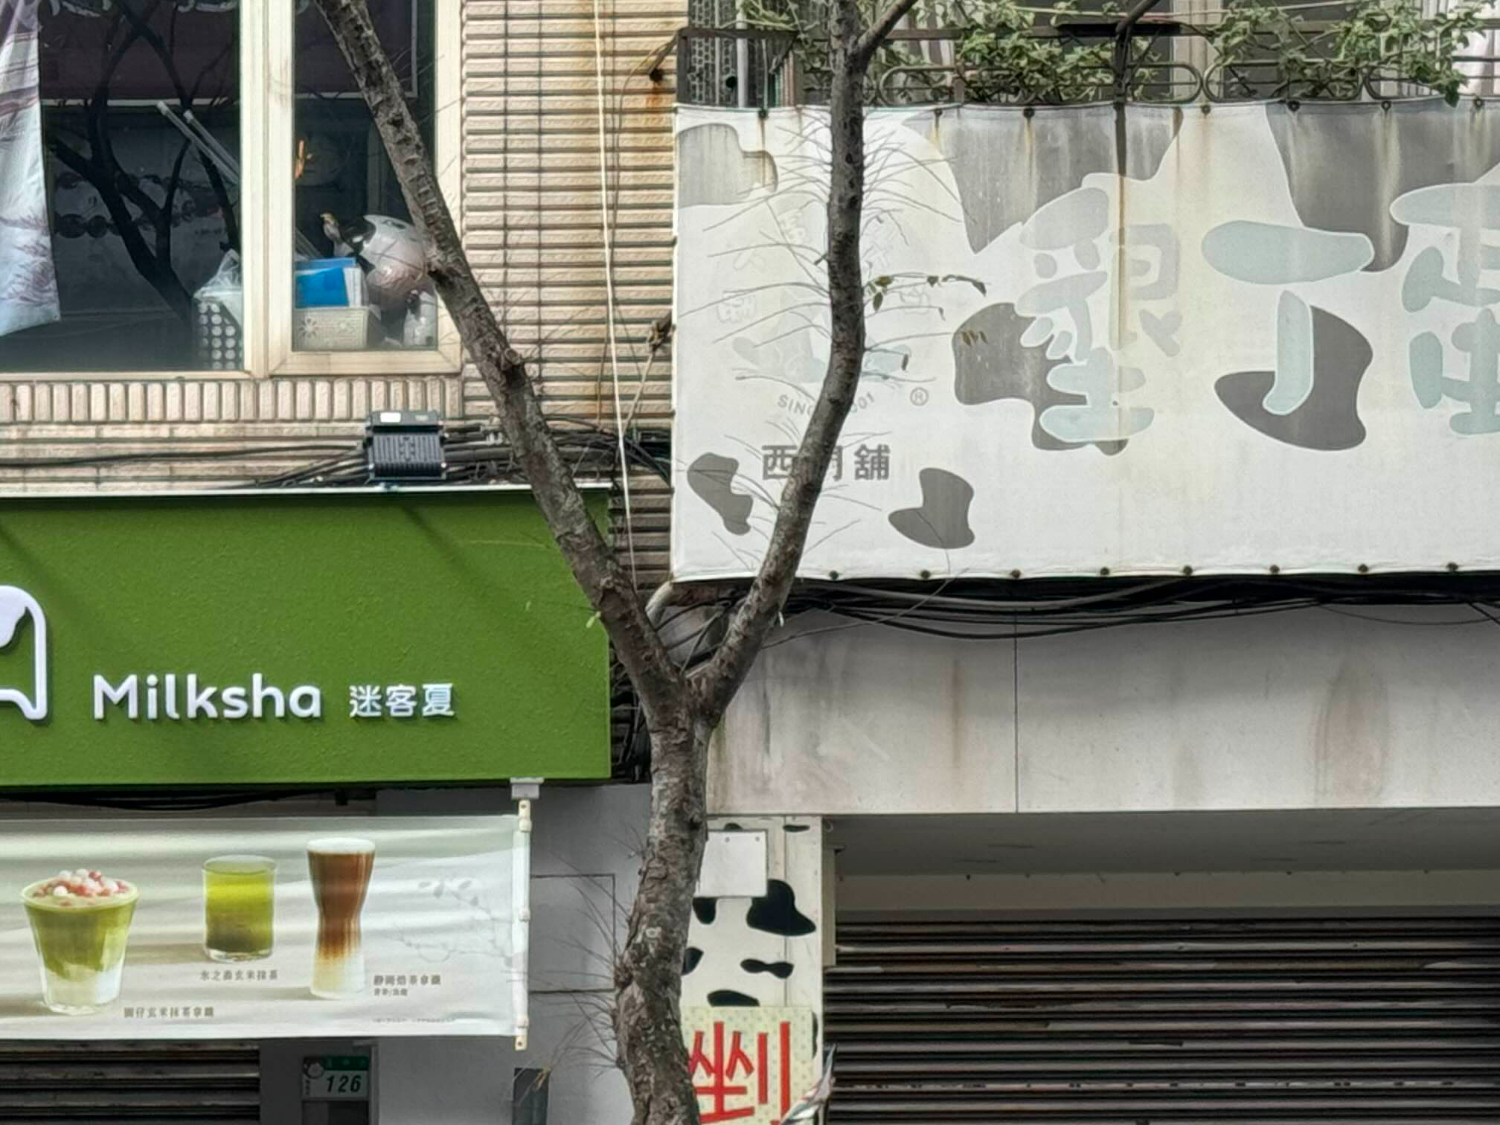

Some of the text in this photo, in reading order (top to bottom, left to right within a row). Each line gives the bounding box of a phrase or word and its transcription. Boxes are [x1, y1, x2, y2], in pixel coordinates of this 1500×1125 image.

[93, 673, 321, 719] Milksha
[349, 683, 455, 717] 迷客夏
[326, 1074, 362, 1093] 126
